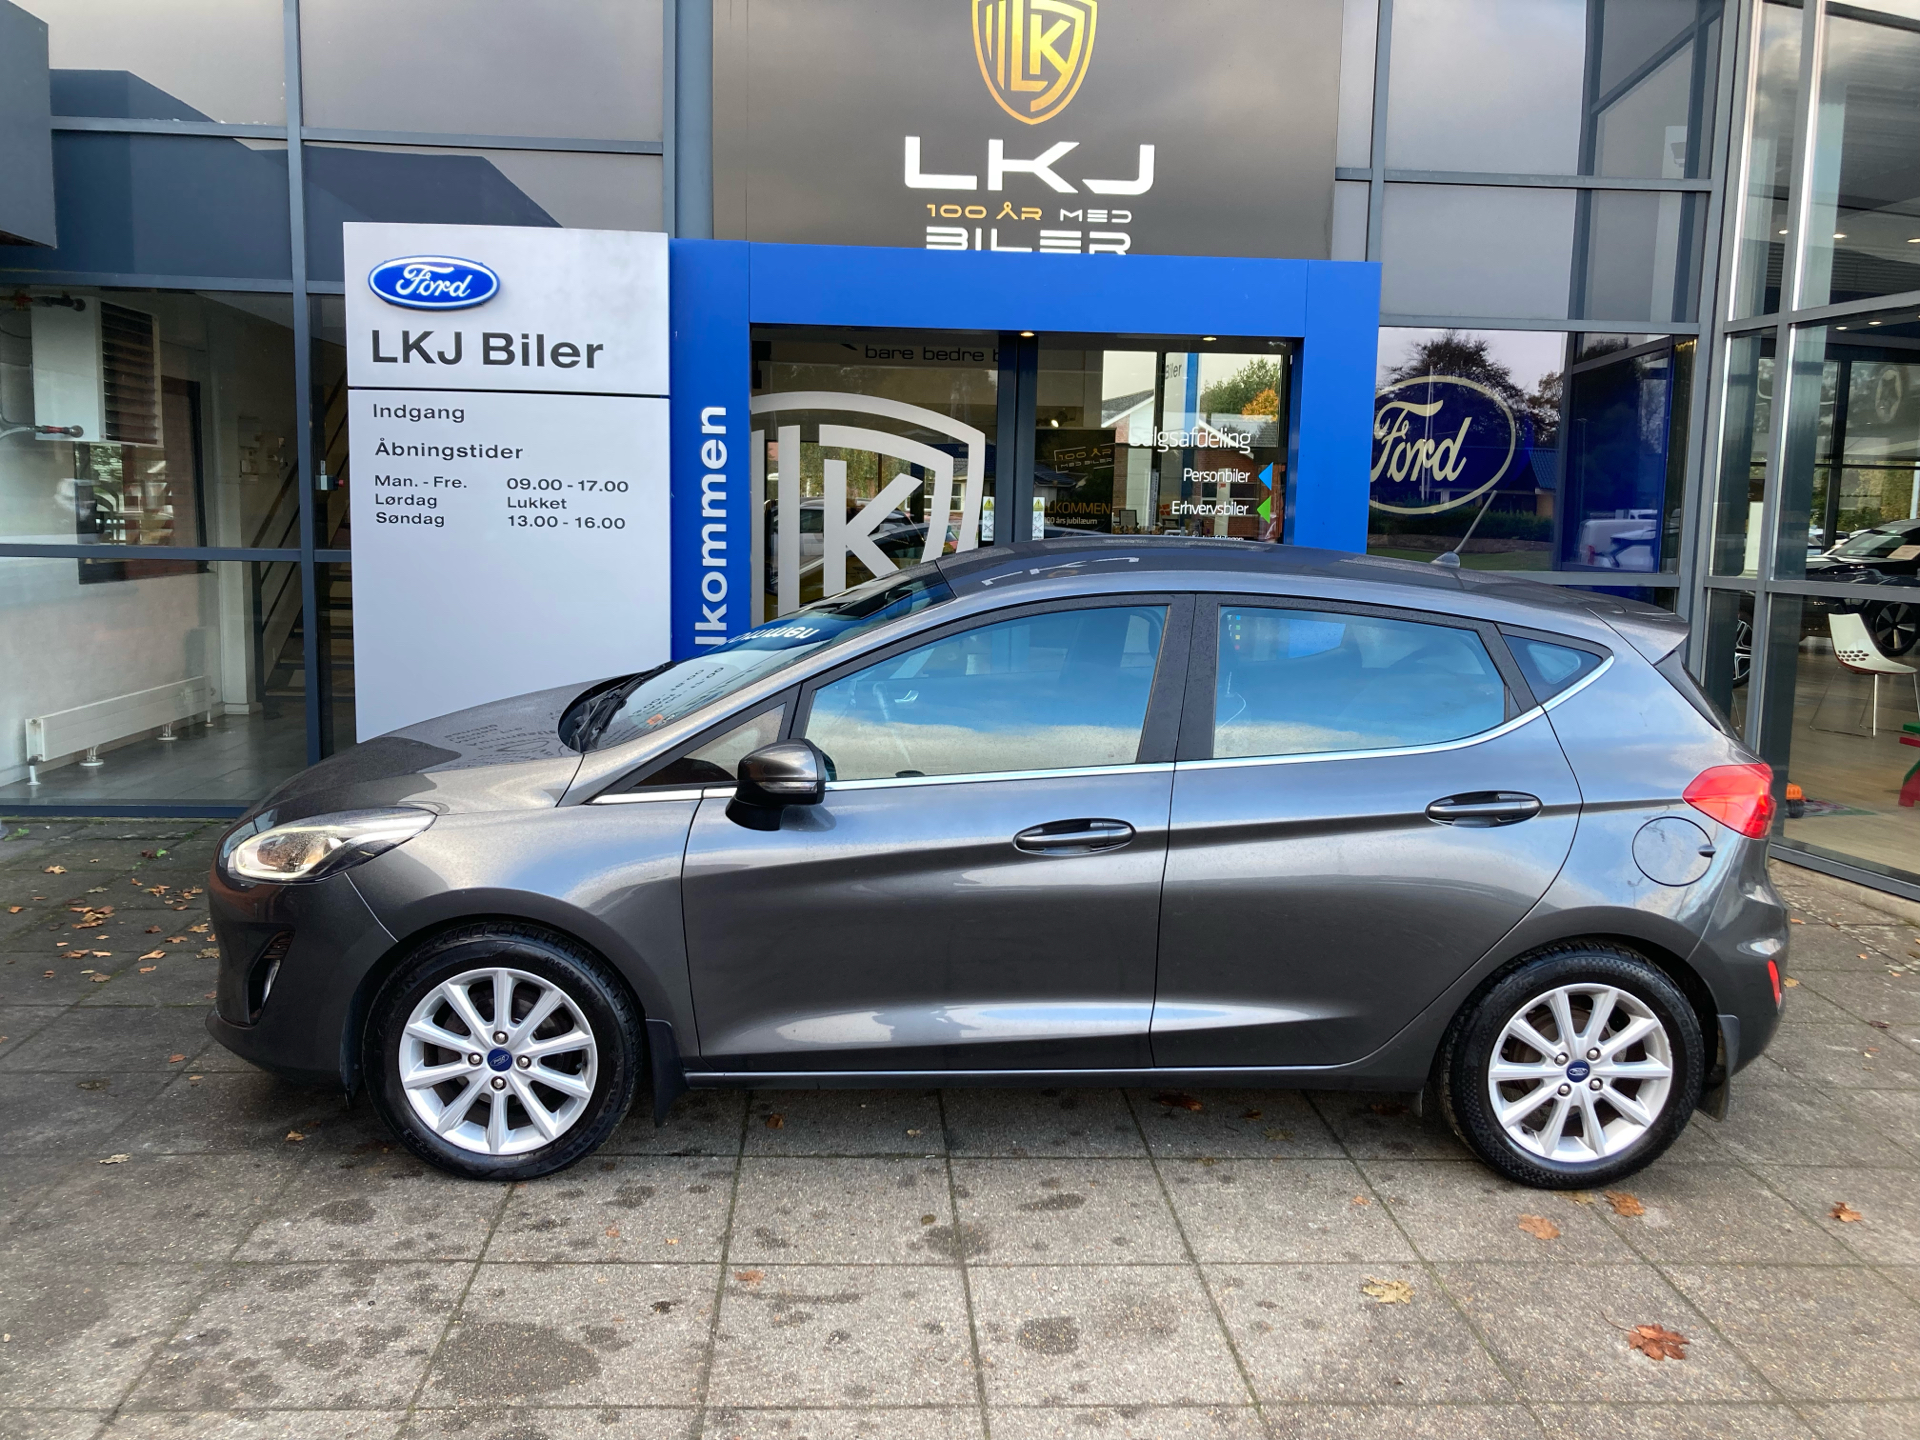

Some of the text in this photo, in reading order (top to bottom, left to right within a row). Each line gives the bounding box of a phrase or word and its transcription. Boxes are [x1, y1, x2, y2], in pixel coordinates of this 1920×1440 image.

[904, 135, 1155, 196] LKJ
[926, 201, 1133, 224] 100 ÅR MED
[925, 225, 1132, 256] BILER
[395, 263, 472, 299] Ford
[371, 329, 604, 369] LKJ Biler
[865, 344, 914, 360] bare
[922, 346, 985, 363] bedre
[372, 403, 466, 424] Indgang
[374, 437, 524, 461] Åbningstider
[1370, 399, 1473, 483] Ford
[374, 475, 418, 488] Man.
[433, 476, 468, 489] Fre.
[1183, 467, 1251, 483] Personbiler
[374, 493, 438, 509] Lørdag
[507, 496, 568, 510] Lukket
[1044, 501, 1111, 515] LKOMMEN
[1171, 500, 1250, 516] Erhvervsbiler
[375, 511, 446, 528] Søndag
[694, 405, 729, 646] lkommen
